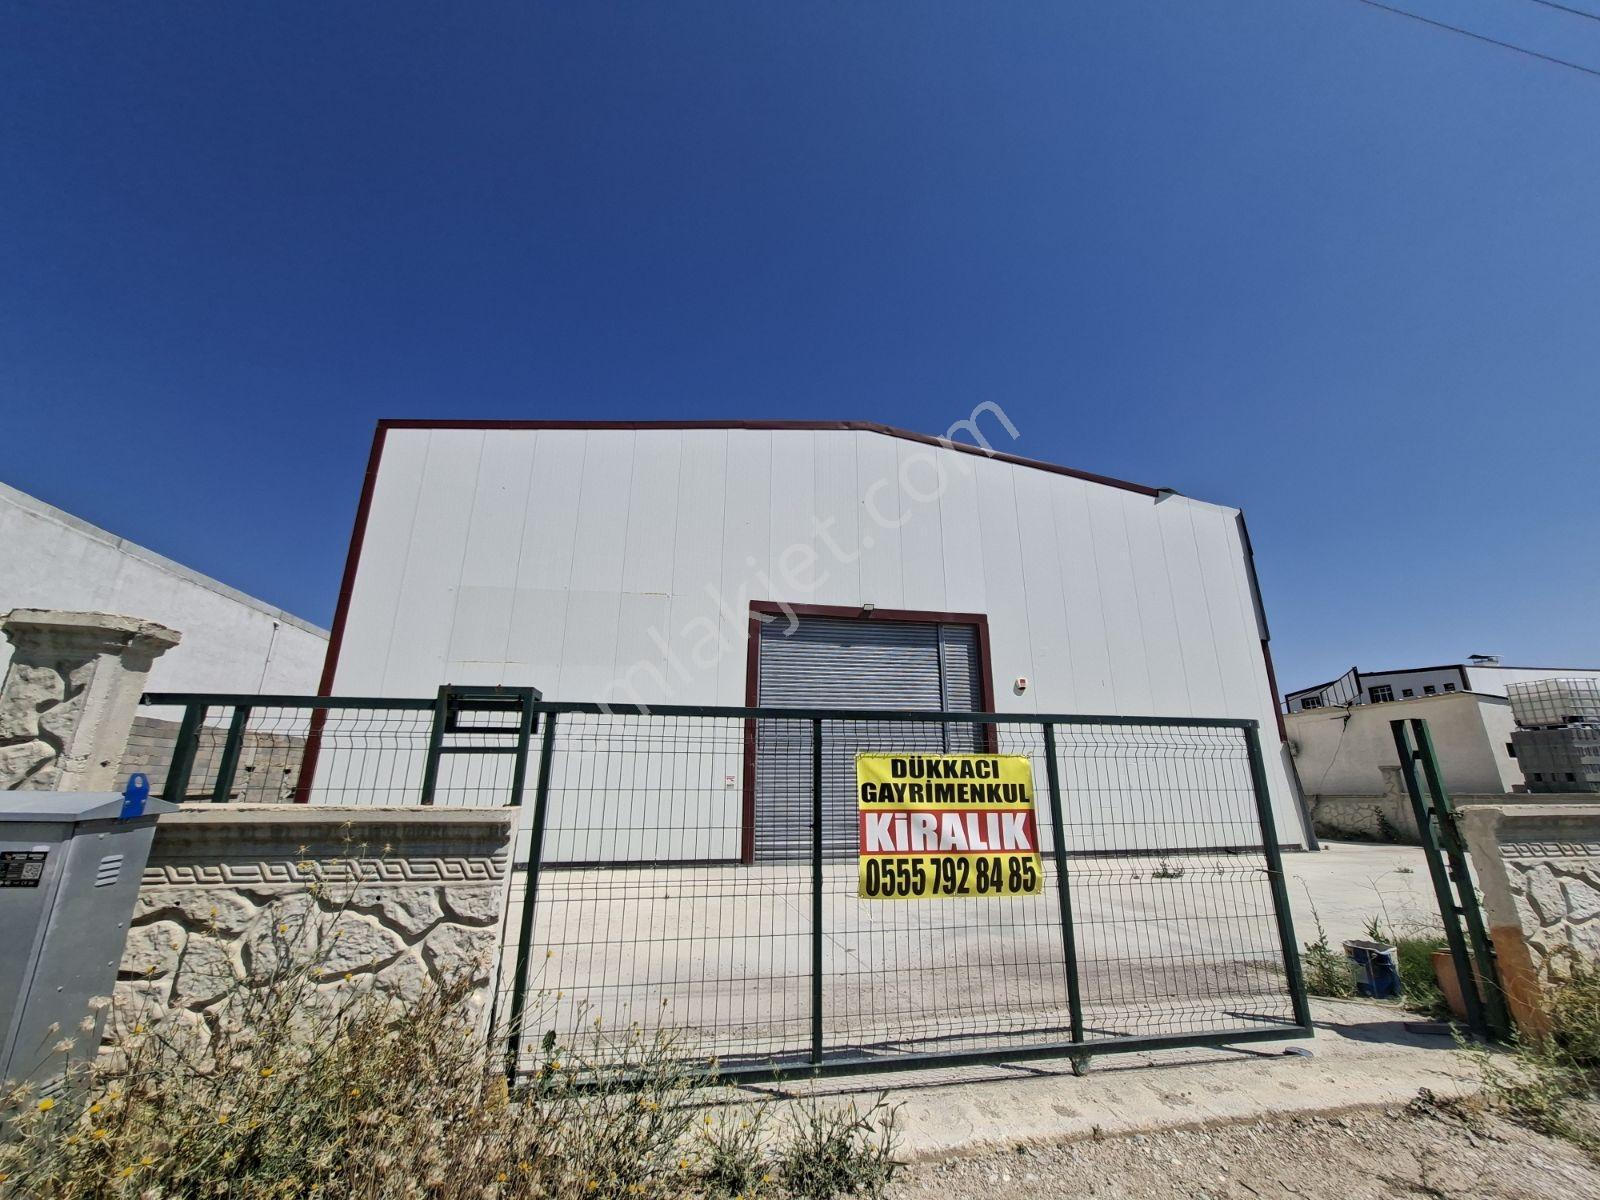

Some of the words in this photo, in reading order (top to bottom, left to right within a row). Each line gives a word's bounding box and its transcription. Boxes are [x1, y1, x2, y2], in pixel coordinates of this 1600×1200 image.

[891, 756, 1000, 779] DÜKKACI
[861, 780, 1030, 803] GAYRİMENKUL
[866, 858, 926, 897] 0555
[930, 857, 970, 895] 792
[976, 857, 1003, 894] 84
[1008, 856, 1037, 893] 85
